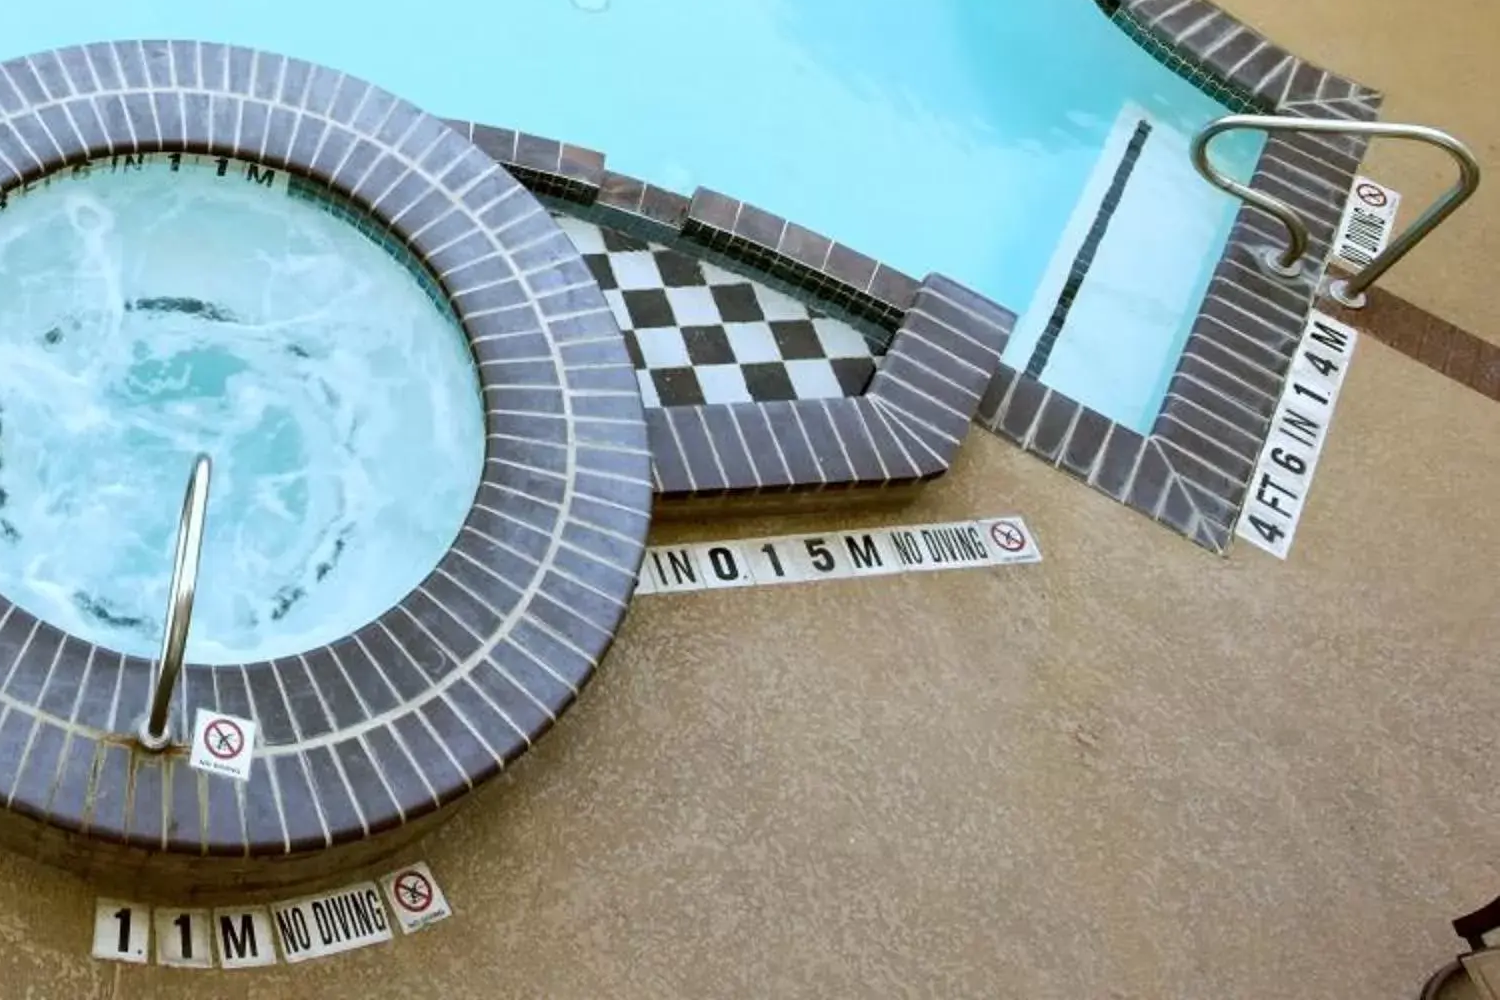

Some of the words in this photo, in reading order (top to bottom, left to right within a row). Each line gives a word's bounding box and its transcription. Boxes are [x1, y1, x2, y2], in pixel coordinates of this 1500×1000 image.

[246, 163, 276, 189] M
[1344, 206, 1386, 253] DIVING
[1313, 320, 1349, 354] M
[1280, 410, 1321, 447] IN
[1271, 447, 1307, 475] 6
[1256, 473, 1299, 520] FT
[1249, 513, 1285, 545] 4
[652, 549, 698, 586] IN
[847, 534, 883, 569] M
[890, 531, 923, 565] NO
[921, 526, 989, 563] DIVING
[220, 913, 259, 960] M
[276, 907, 311, 955] NO
[312, 888, 387, 947] DIVING
